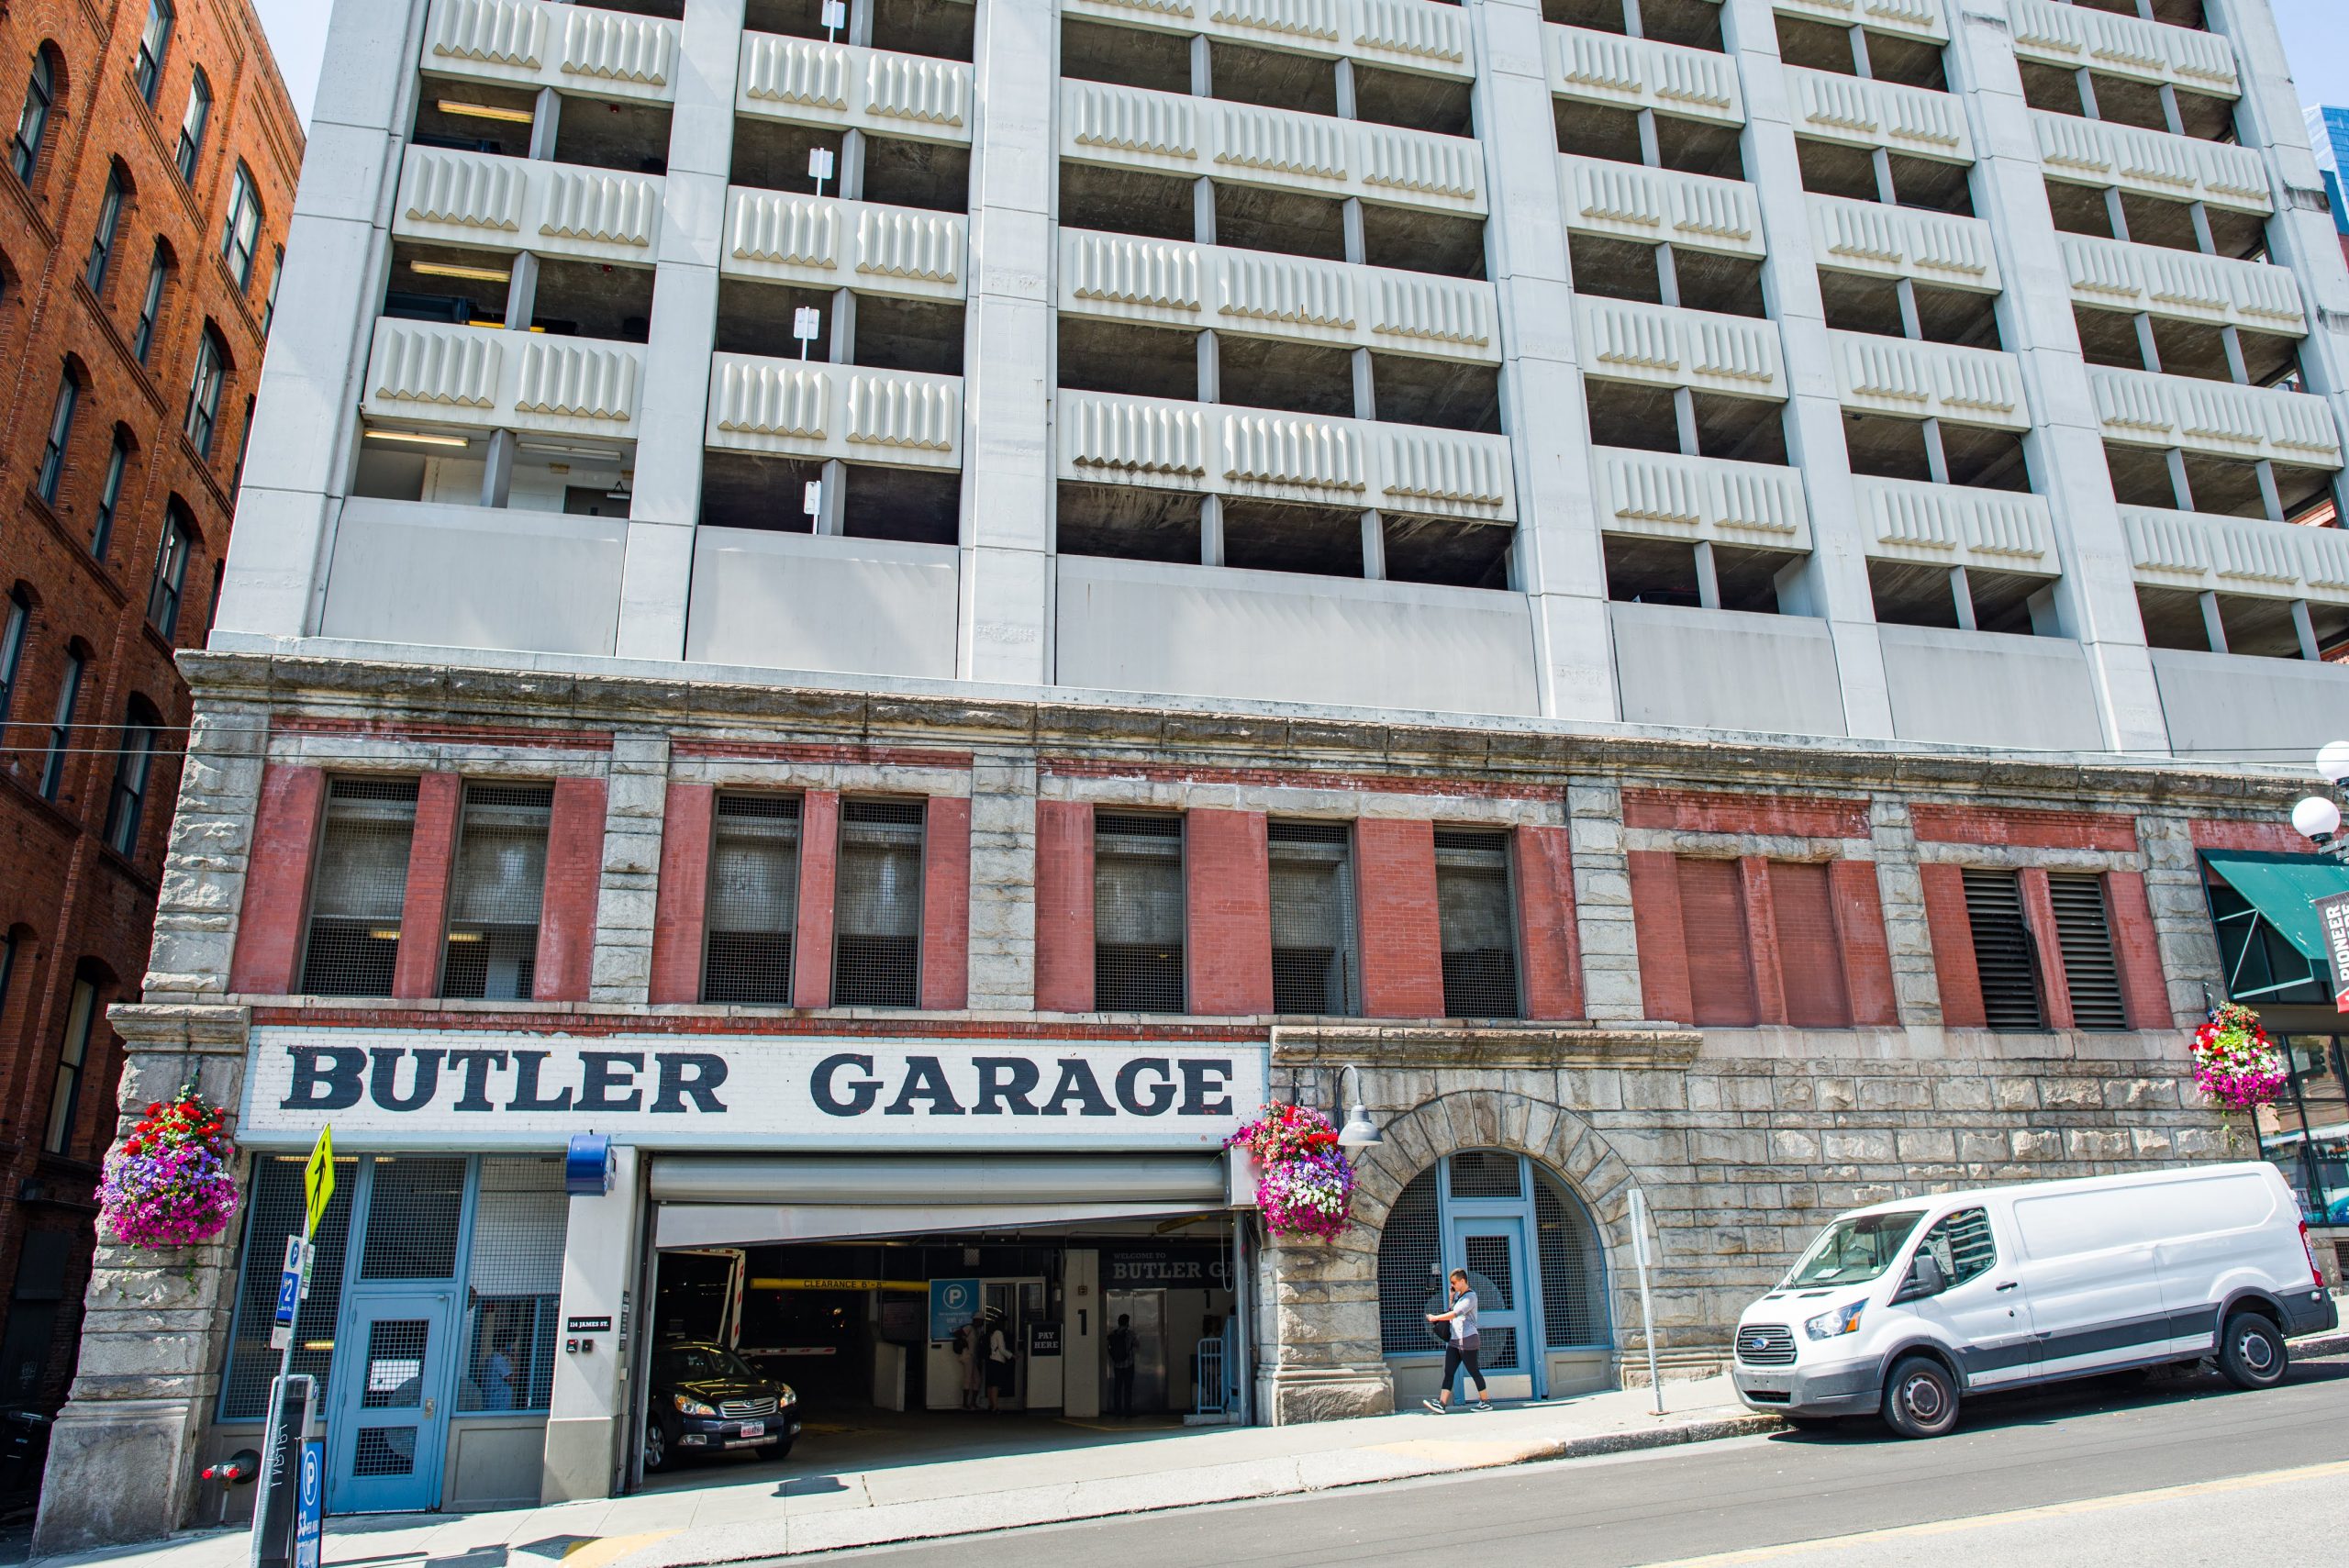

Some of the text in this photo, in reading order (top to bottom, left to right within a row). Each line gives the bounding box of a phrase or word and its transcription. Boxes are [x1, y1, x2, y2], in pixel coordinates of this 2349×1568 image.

[2325, 904, 2349, 982] PIONEER
[280, 1045, 1233, 1117] BUTLER GARAGE
[1113, 1251, 1154, 1260] WELCOME
[1113, 1262, 1203, 1279] BUTLER
[804, 1280, 857, 1289] CLEARANCE
[949, 1289, 963, 1305] P
[1077, 1308, 1087, 1336] 1
[1038, 1331, 1054, 1340] PAY
[306, 1462, 315, 1496] P
